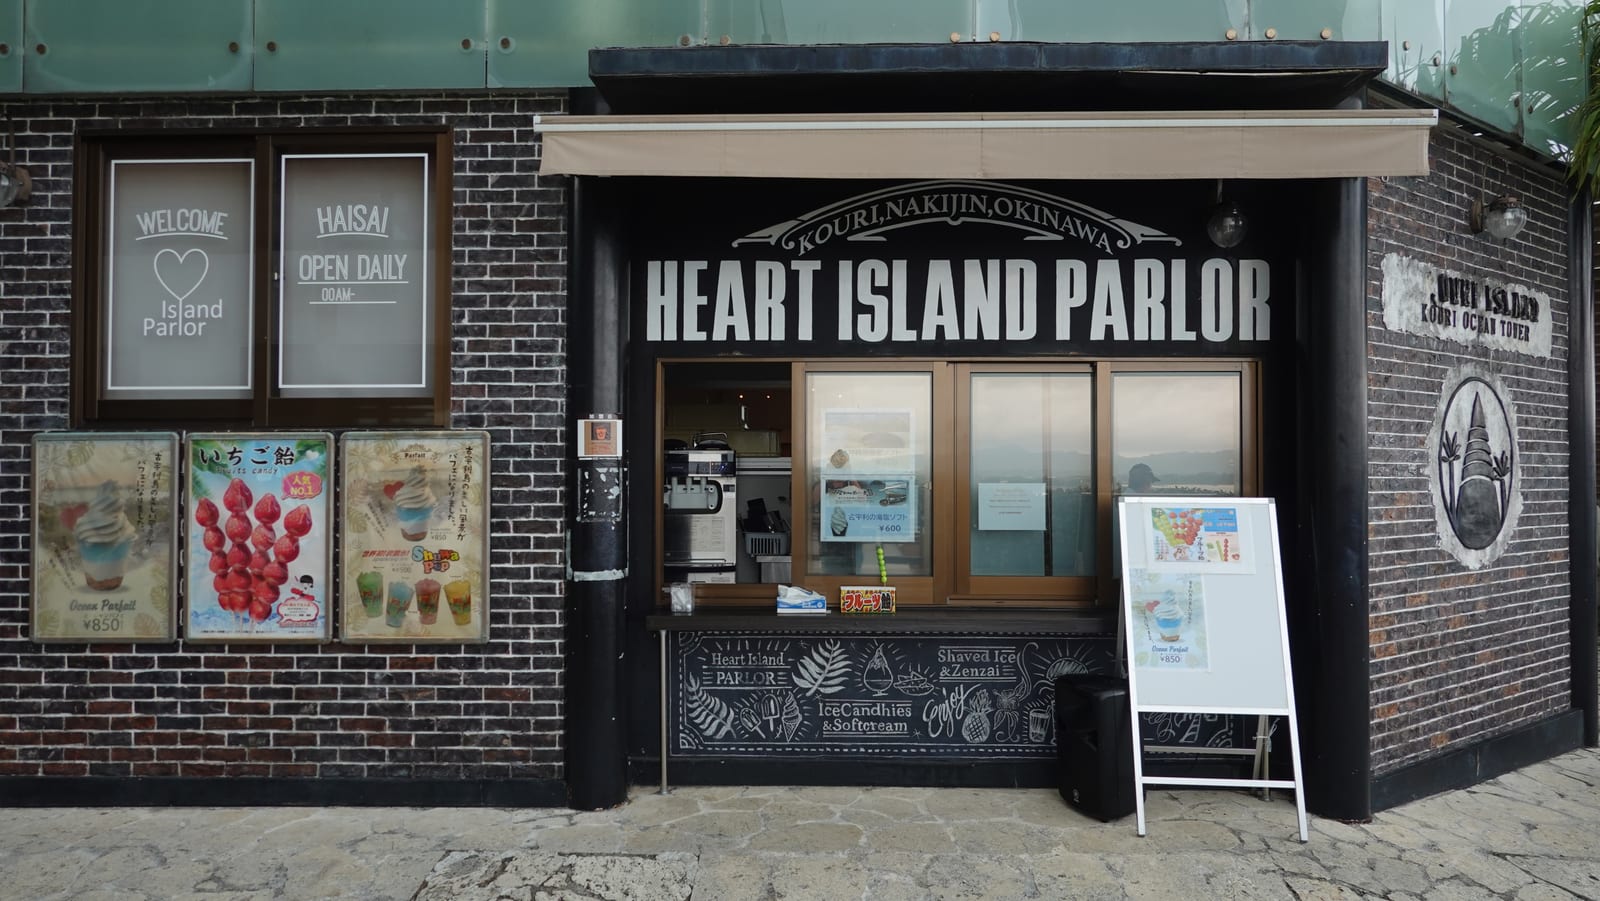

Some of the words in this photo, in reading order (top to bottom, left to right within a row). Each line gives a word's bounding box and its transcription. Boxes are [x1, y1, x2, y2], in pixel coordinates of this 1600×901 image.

[136, 209, 228, 235] WELCOME
[317, 204, 389, 234] HAISAI
[299, 254, 349, 280] OPEN
[357, 254, 408, 280] DAILY
[162, 299, 223, 319] Island
[646, 259, 822, 341] HEART
[838, 259, 1037, 342] ISLAND
[1056, 259, 1272, 342] PARLOR
[143, 317, 207, 337] Parlor
[1421, 303, 1457, 328] KOURI
[1462, 311, 1496, 336] OCEAN
[1500, 319, 1530, 342] TOWER
[200, 445, 295, 466] いちご飴
[292, 475, 312, 485] 人気
[844, 591, 893, 611] フルーツ飴
[82, 617, 120, 631] ¥850
[711, 652, 746, 665] Heart
[748, 652, 785, 665] Island
[937, 648, 991, 663] Shaved
[994, 650, 1017, 663] Ice
[1160, 655, 1181, 663] ¥850
[716, 671, 777, 685] PARLOR
